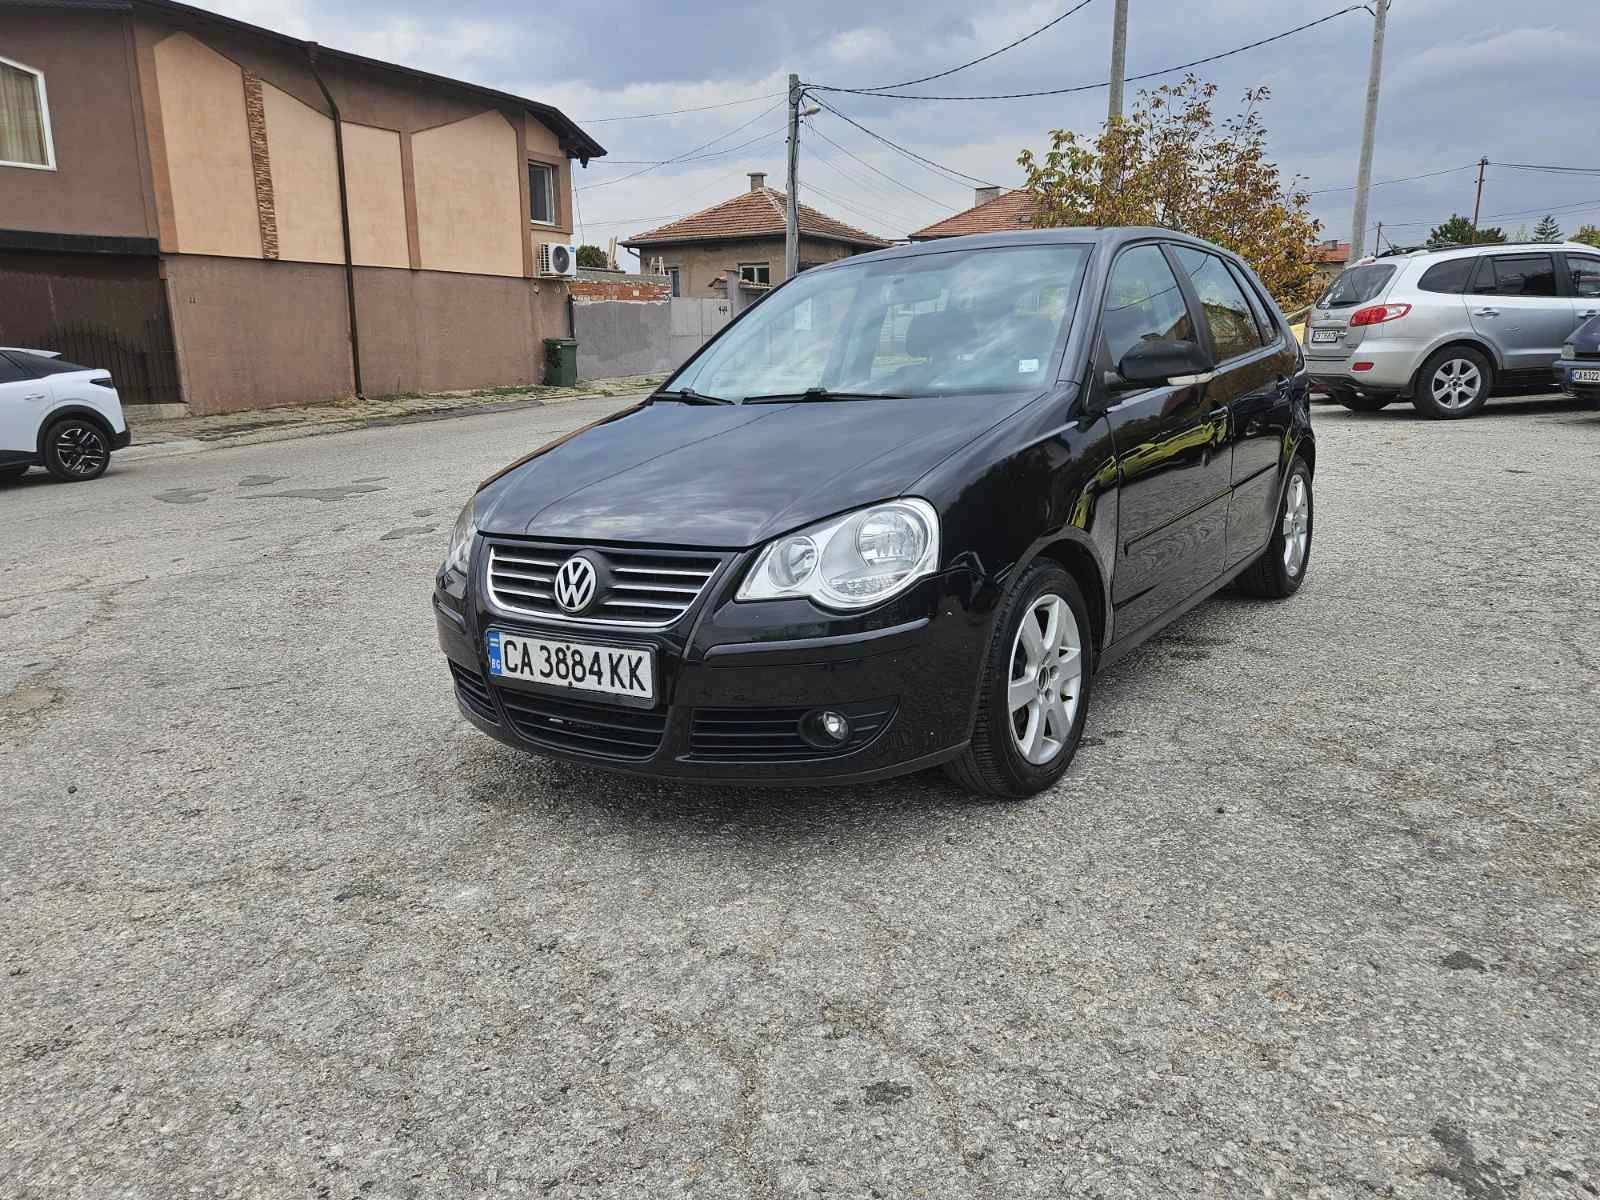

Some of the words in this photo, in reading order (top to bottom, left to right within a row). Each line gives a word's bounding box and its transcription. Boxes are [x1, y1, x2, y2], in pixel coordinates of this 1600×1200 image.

[554, 556, 597, 612] VW
[504, 640, 534, 676] CA
[539, 644, 604, 686] 3884
[607, 652, 647, 692] KK
